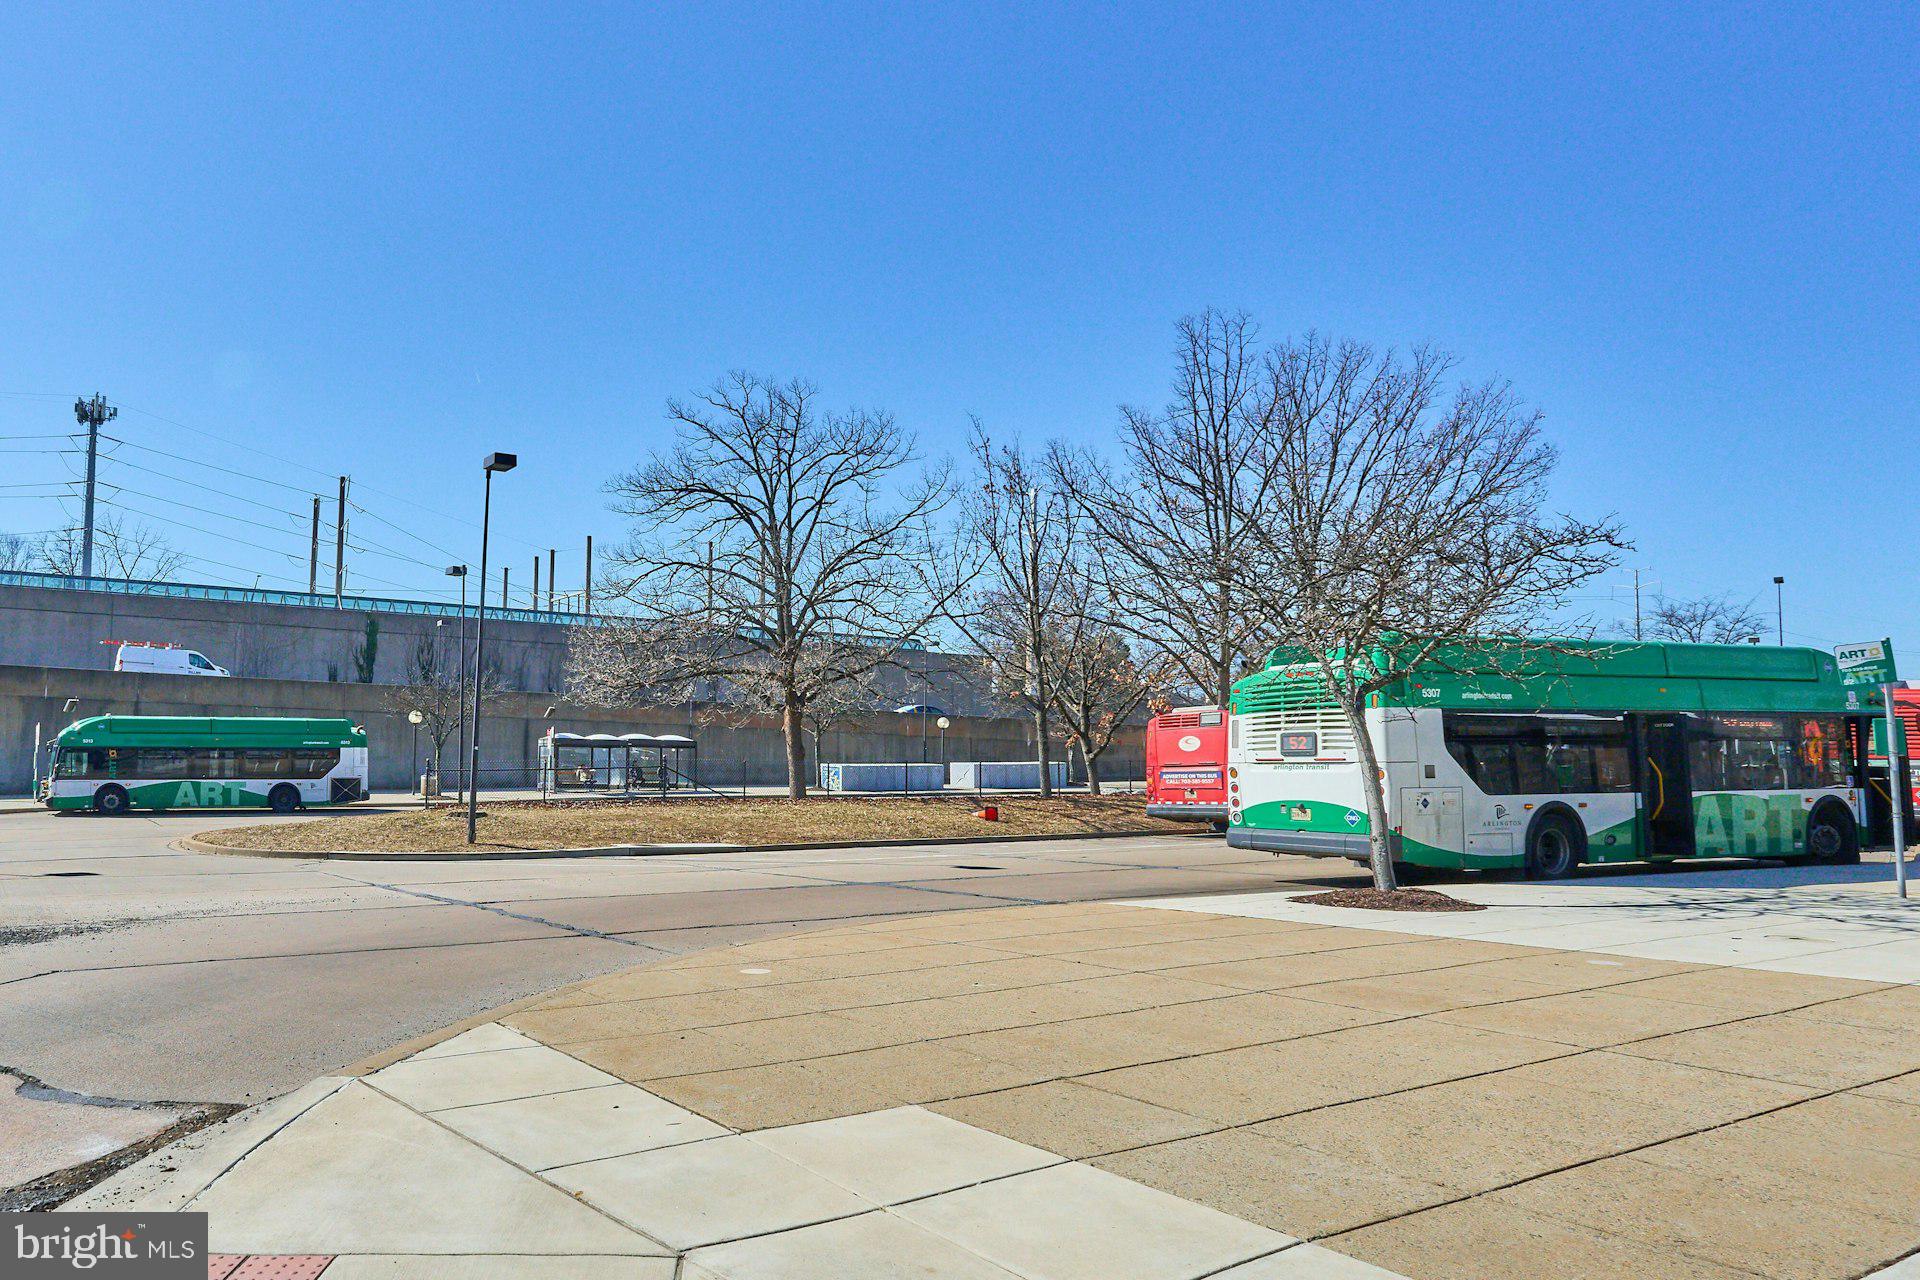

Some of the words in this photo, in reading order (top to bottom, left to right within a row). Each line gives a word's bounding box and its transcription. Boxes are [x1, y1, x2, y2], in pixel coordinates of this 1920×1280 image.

[1840, 649, 1867, 659] ART
[1422, 688, 1441, 698] 5307
[1289, 736, 1308, 750] 52
[1273, 763, 1304, 771] arlington
[173, 781, 246, 806] ART
[1483, 820, 1522, 828] ARLINGTON
[1695, 794, 1802, 856] ART
